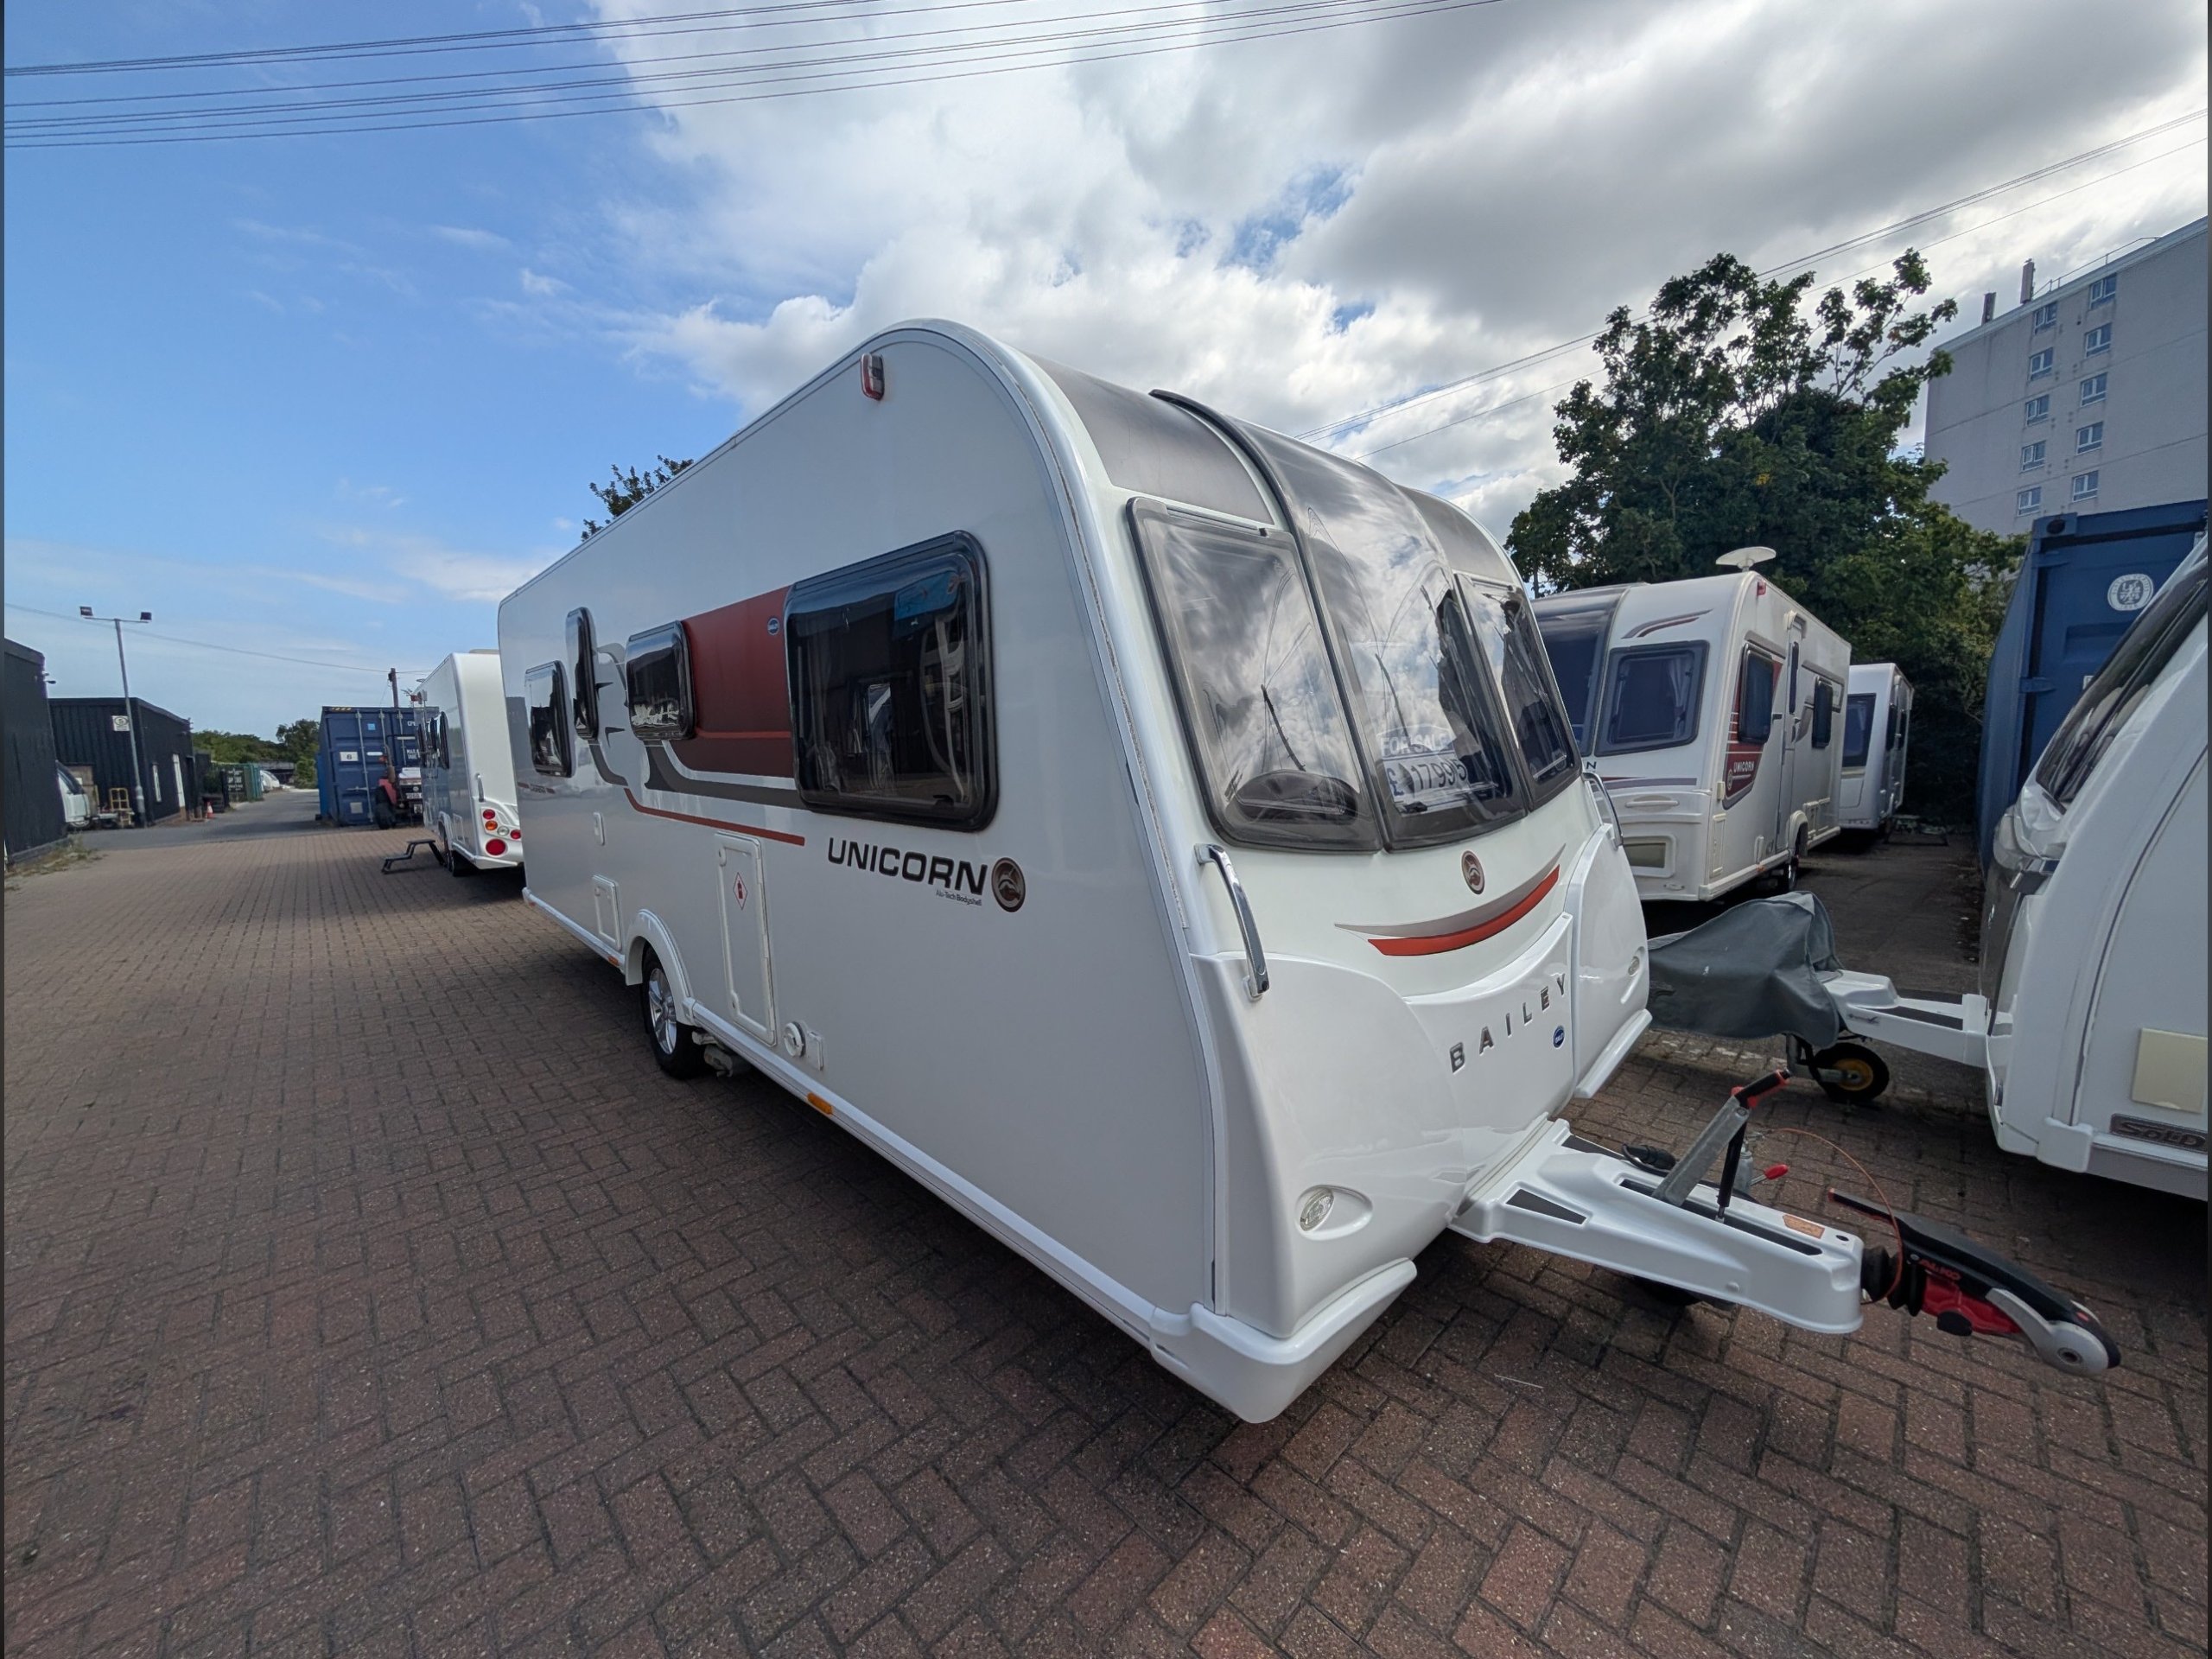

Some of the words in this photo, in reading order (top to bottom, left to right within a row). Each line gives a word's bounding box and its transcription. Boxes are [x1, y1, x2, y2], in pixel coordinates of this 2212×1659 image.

[1733, 760, 1755, 772] UNICORN
[828, 837, 988, 896] UNICORN
[1449, 973, 1566, 1074] BAILEY
